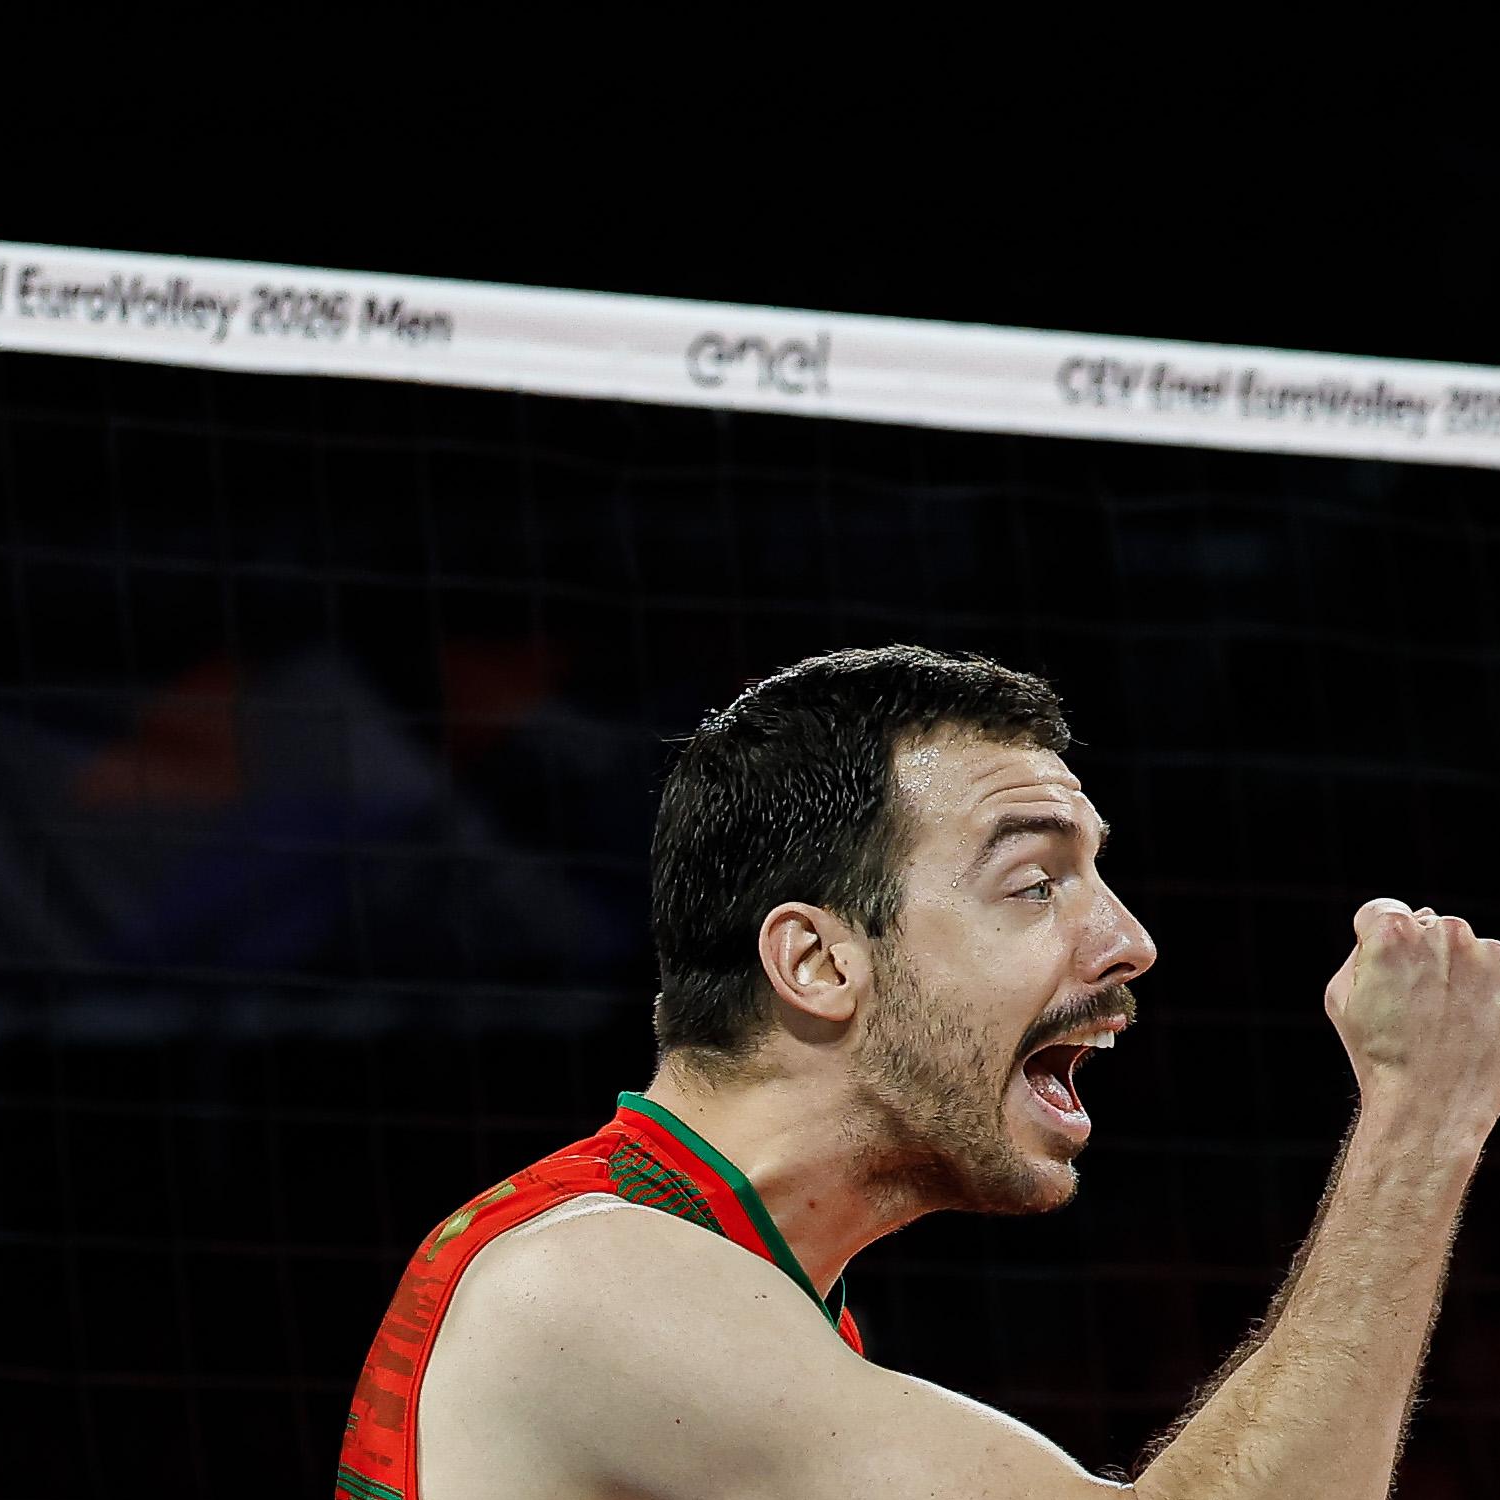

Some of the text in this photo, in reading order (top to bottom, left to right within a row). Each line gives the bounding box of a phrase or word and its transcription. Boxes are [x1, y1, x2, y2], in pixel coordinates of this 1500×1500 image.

[18, 265, 240, 346] EuroVolley
[250, 285, 350, 341] 2026
[358, 293, 452, 344] Men
[685, 330, 832, 395] enel
